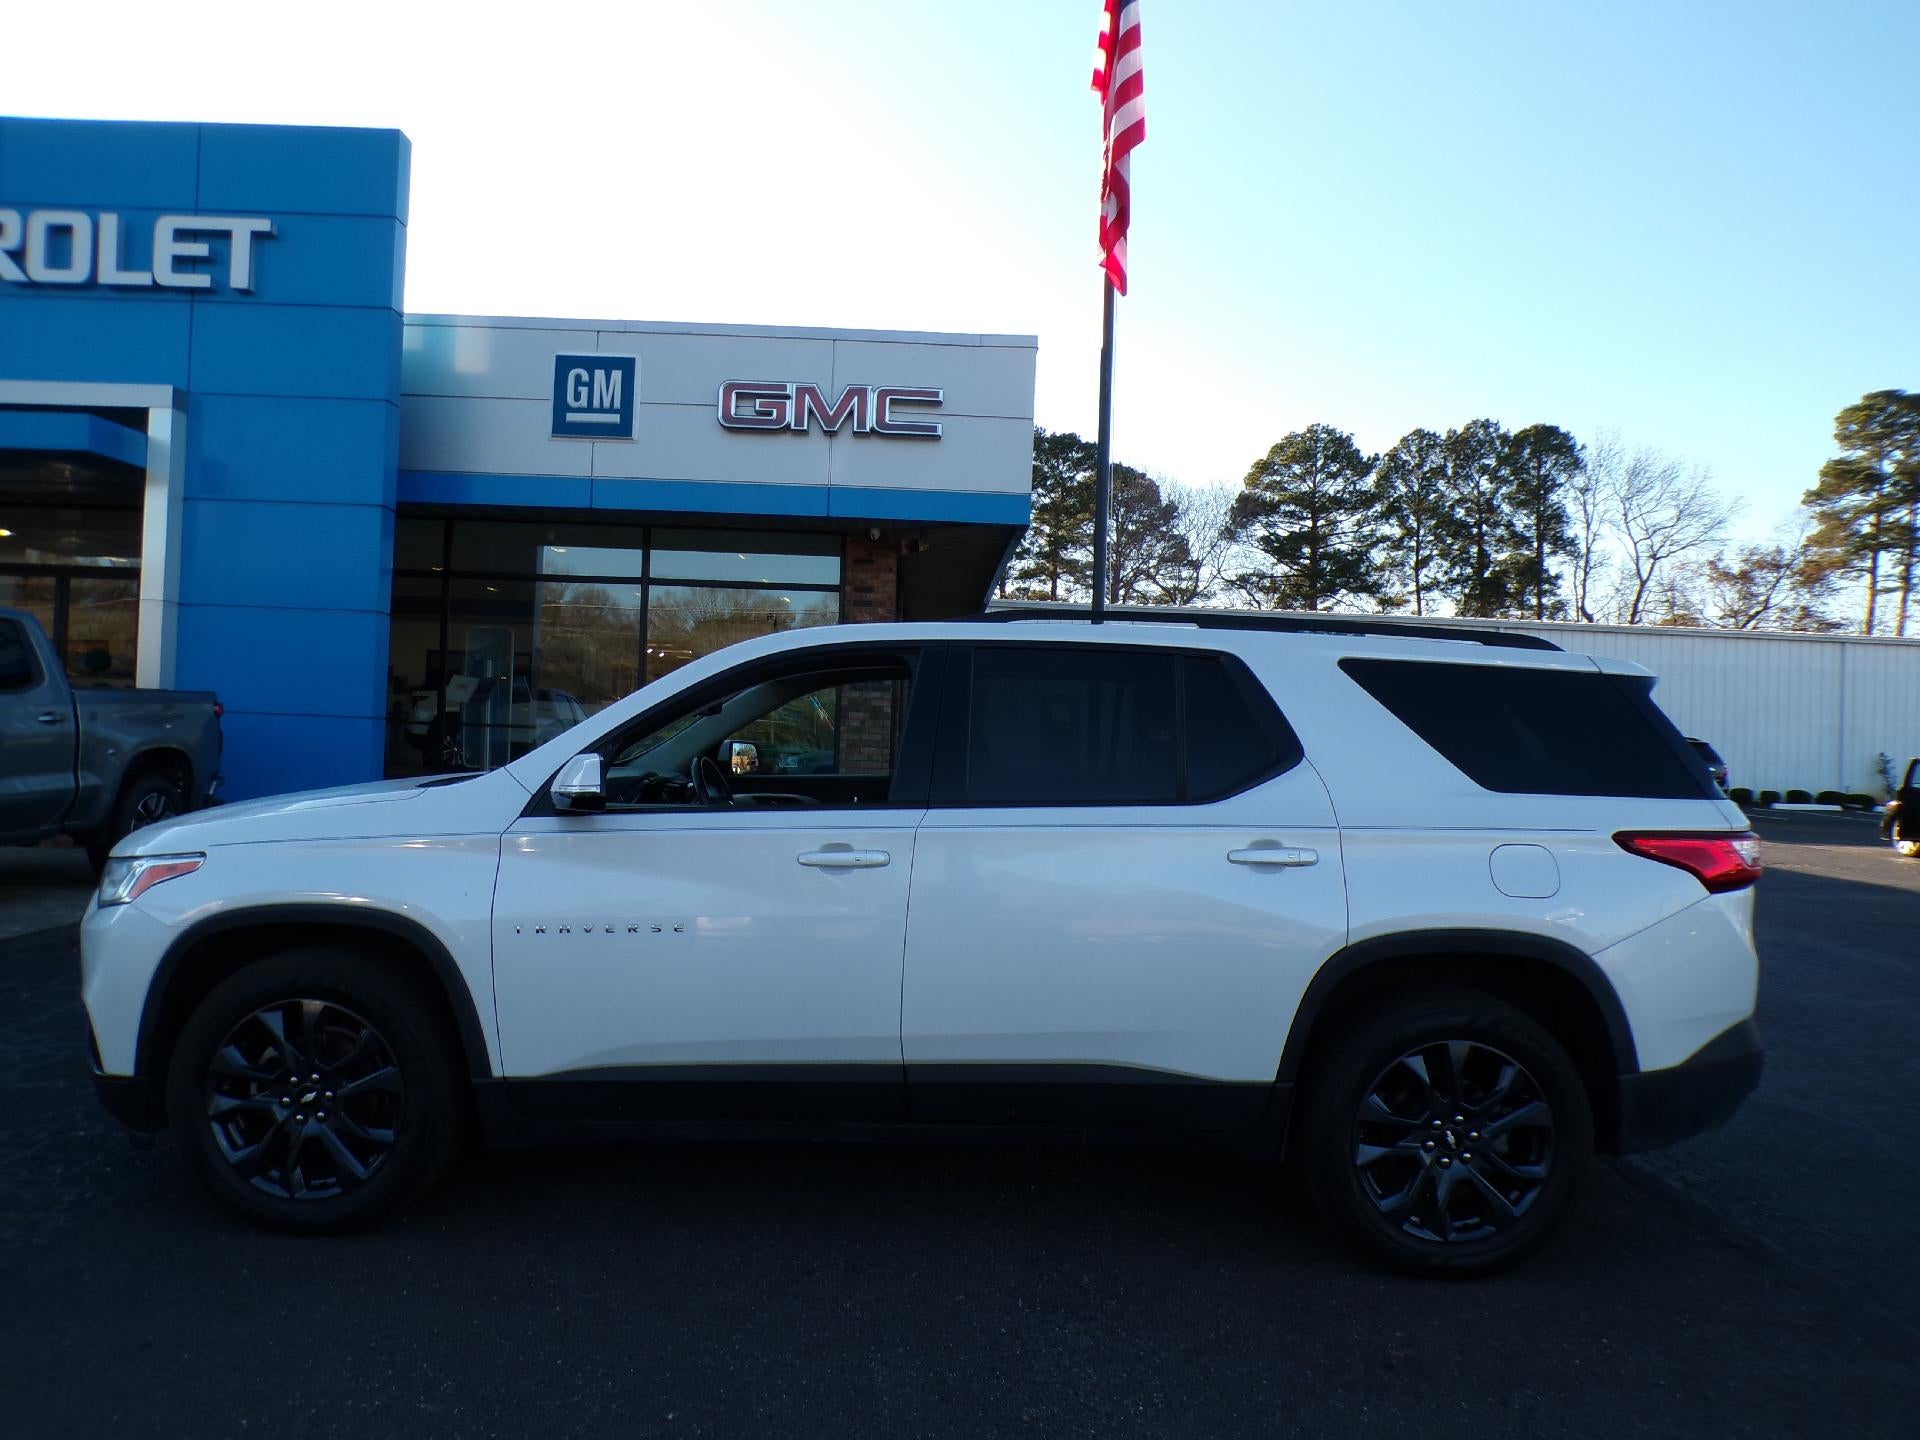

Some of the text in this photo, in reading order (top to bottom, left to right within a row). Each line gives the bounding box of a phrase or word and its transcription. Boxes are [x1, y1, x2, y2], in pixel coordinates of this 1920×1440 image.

[565, 367, 622, 410] GM
[717, 380, 944, 440] GMC
[513, 923, 685, 934] TRAVERSE
